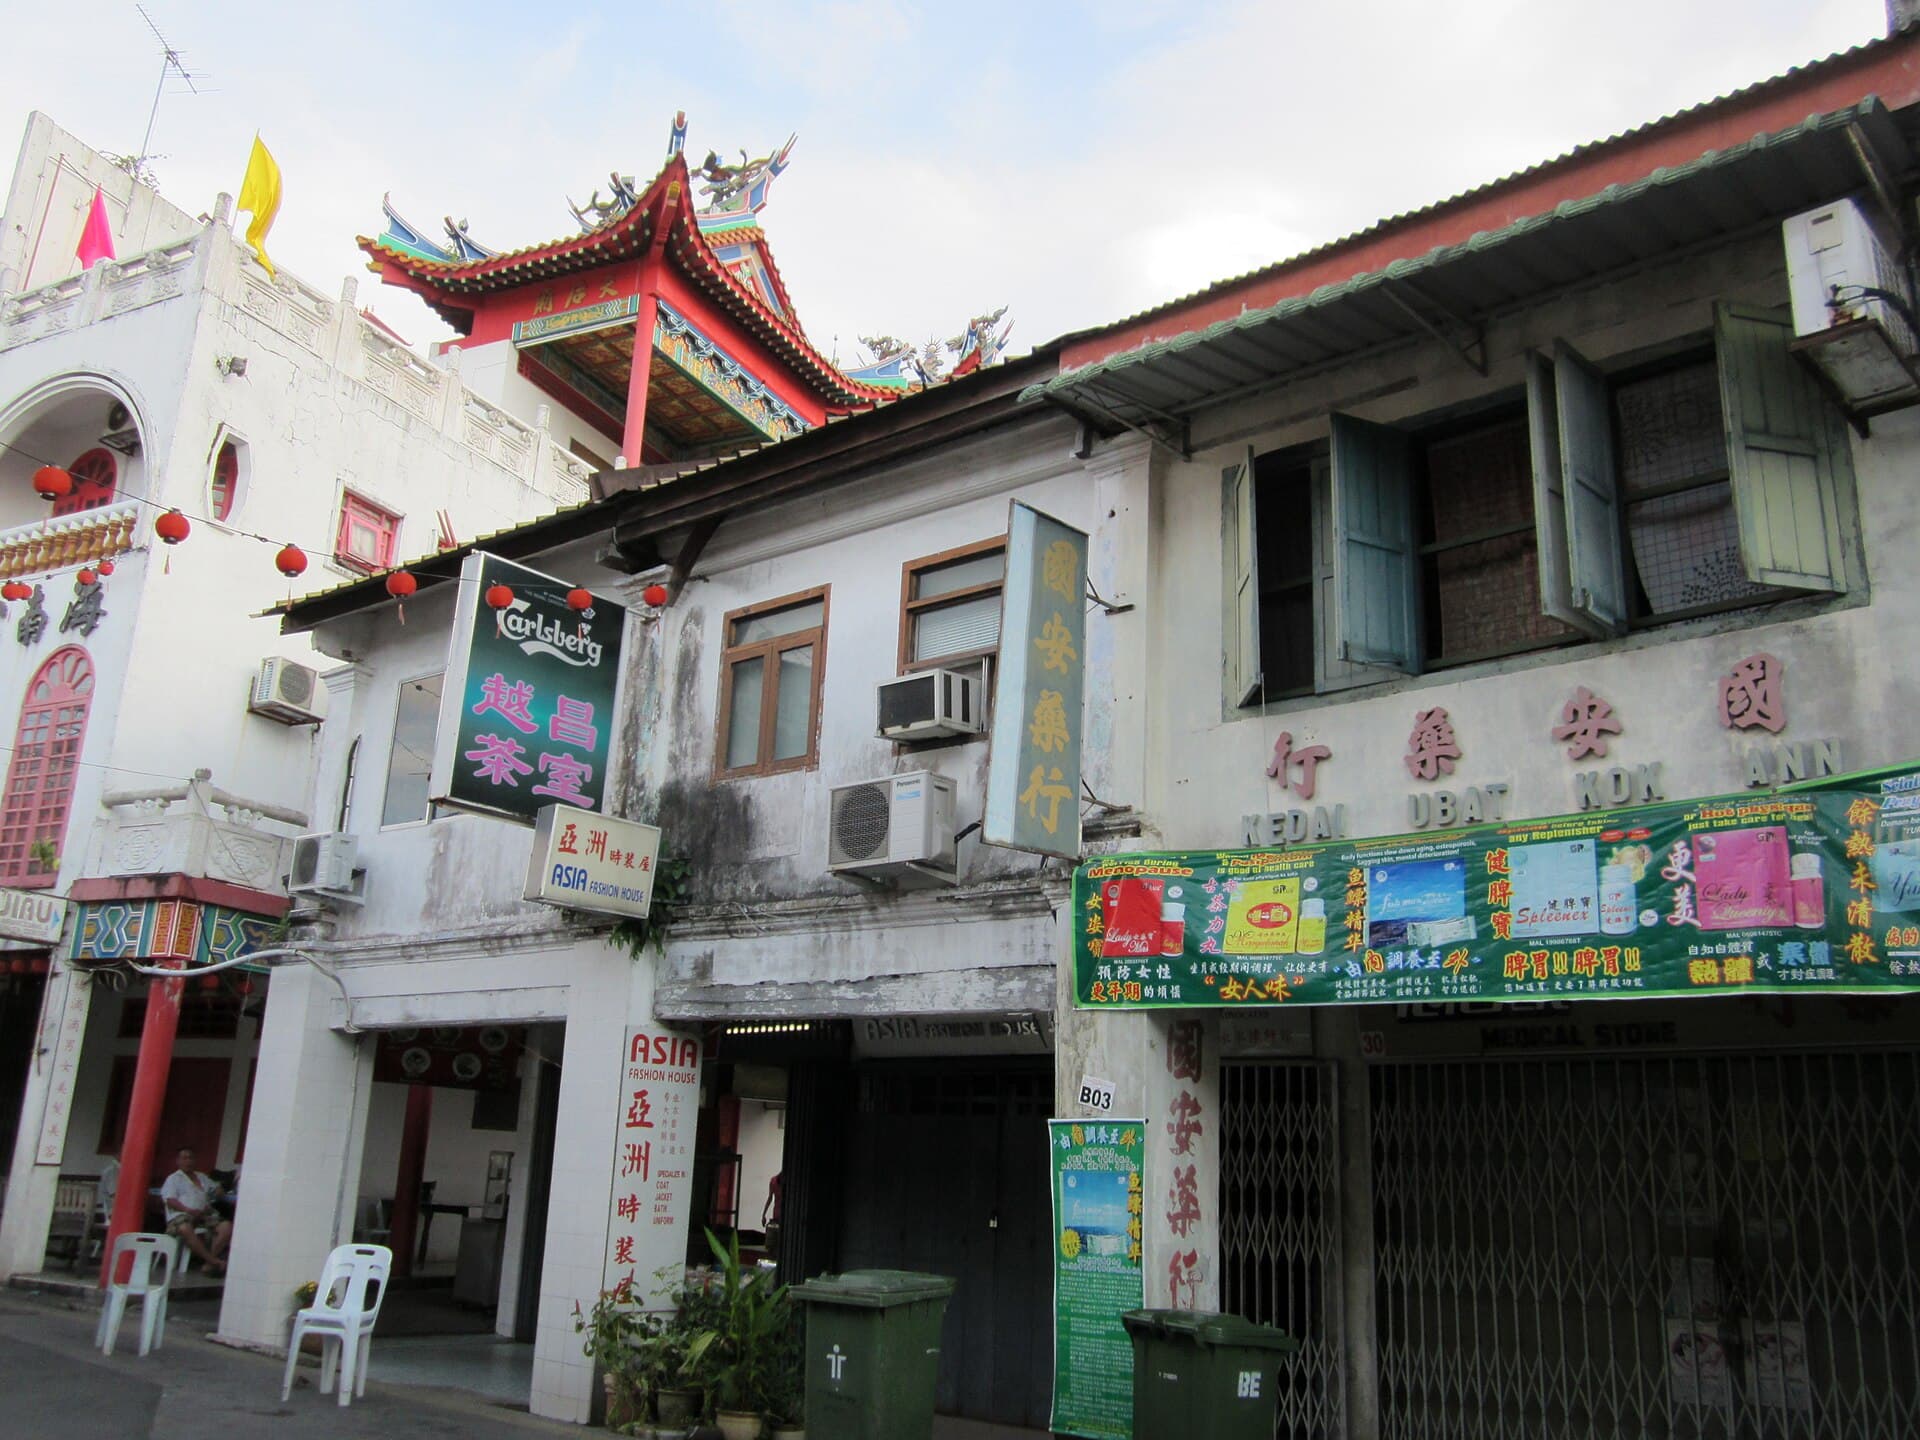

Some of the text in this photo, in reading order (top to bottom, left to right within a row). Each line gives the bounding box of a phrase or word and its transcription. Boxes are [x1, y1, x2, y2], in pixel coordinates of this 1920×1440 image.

[497, 599, 602, 666] Carlsberg
[1241, 737, 1844, 848] KEDAI UBAT KOK ANN
[1688, 822, 1709, 831] just
[1713, 818, 1737, 827] take
[1741, 815, 1767, 824] care
[1509, 832, 1528, 843] any
[1532, 826, 1604, 841] Replenisher
[1357, 851, 1383, 859] functions
[1416, 844, 1435, 852] aging,
[1396, 853, 1416, 861] mental
[1088, 865, 1194, 878] Menopause
[1228, 865, 1250, 875] good
[1264, 862, 1291, 872] health
[1294, 860, 1315, 869] care
[552, 863, 644, 902] ASIA FASHION HOUSE
[1516, 907, 1589, 927] Spleenex
[865, 1018, 919, 1040] ASIA
[1594, 1020, 1677, 1046] STORE
[630, 1033, 697, 1068] ASIA
[1362, 1034, 1383, 1055] 30
[628, 1067, 697, 1084] FASHION HOUSE
[1080, 1086, 1111, 1110] B03
[656, 1181, 670, 1190] COAT
[655, 1192, 673, 1202] JACKET
[653, 1216, 675, 1225] UNIFORM
[1238, 1371, 1261, 1397] BE
